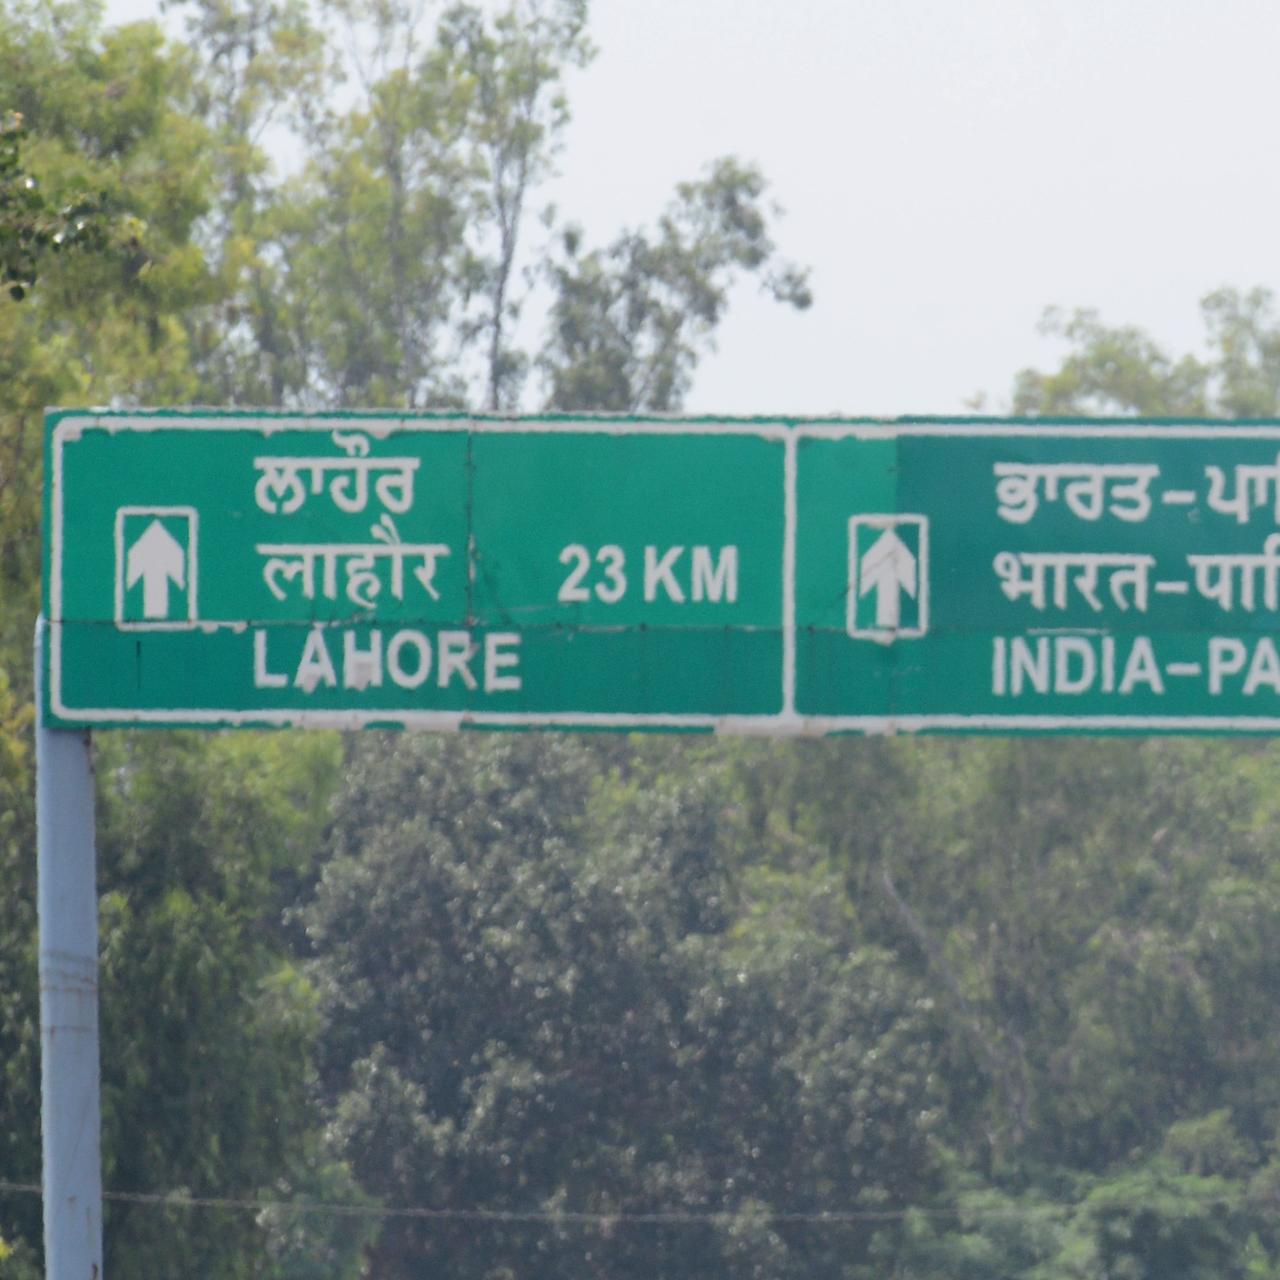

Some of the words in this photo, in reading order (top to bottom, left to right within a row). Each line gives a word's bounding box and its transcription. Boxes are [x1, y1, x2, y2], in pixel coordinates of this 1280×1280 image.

[254, 430, 421, 513] ਲਾਹੌਰ
[256, 513, 452, 608] लाहौर
[559, 546, 626, 602] 23
[644, 546, 738, 602] KM
[255, 631, 521, 691] LAHORE
